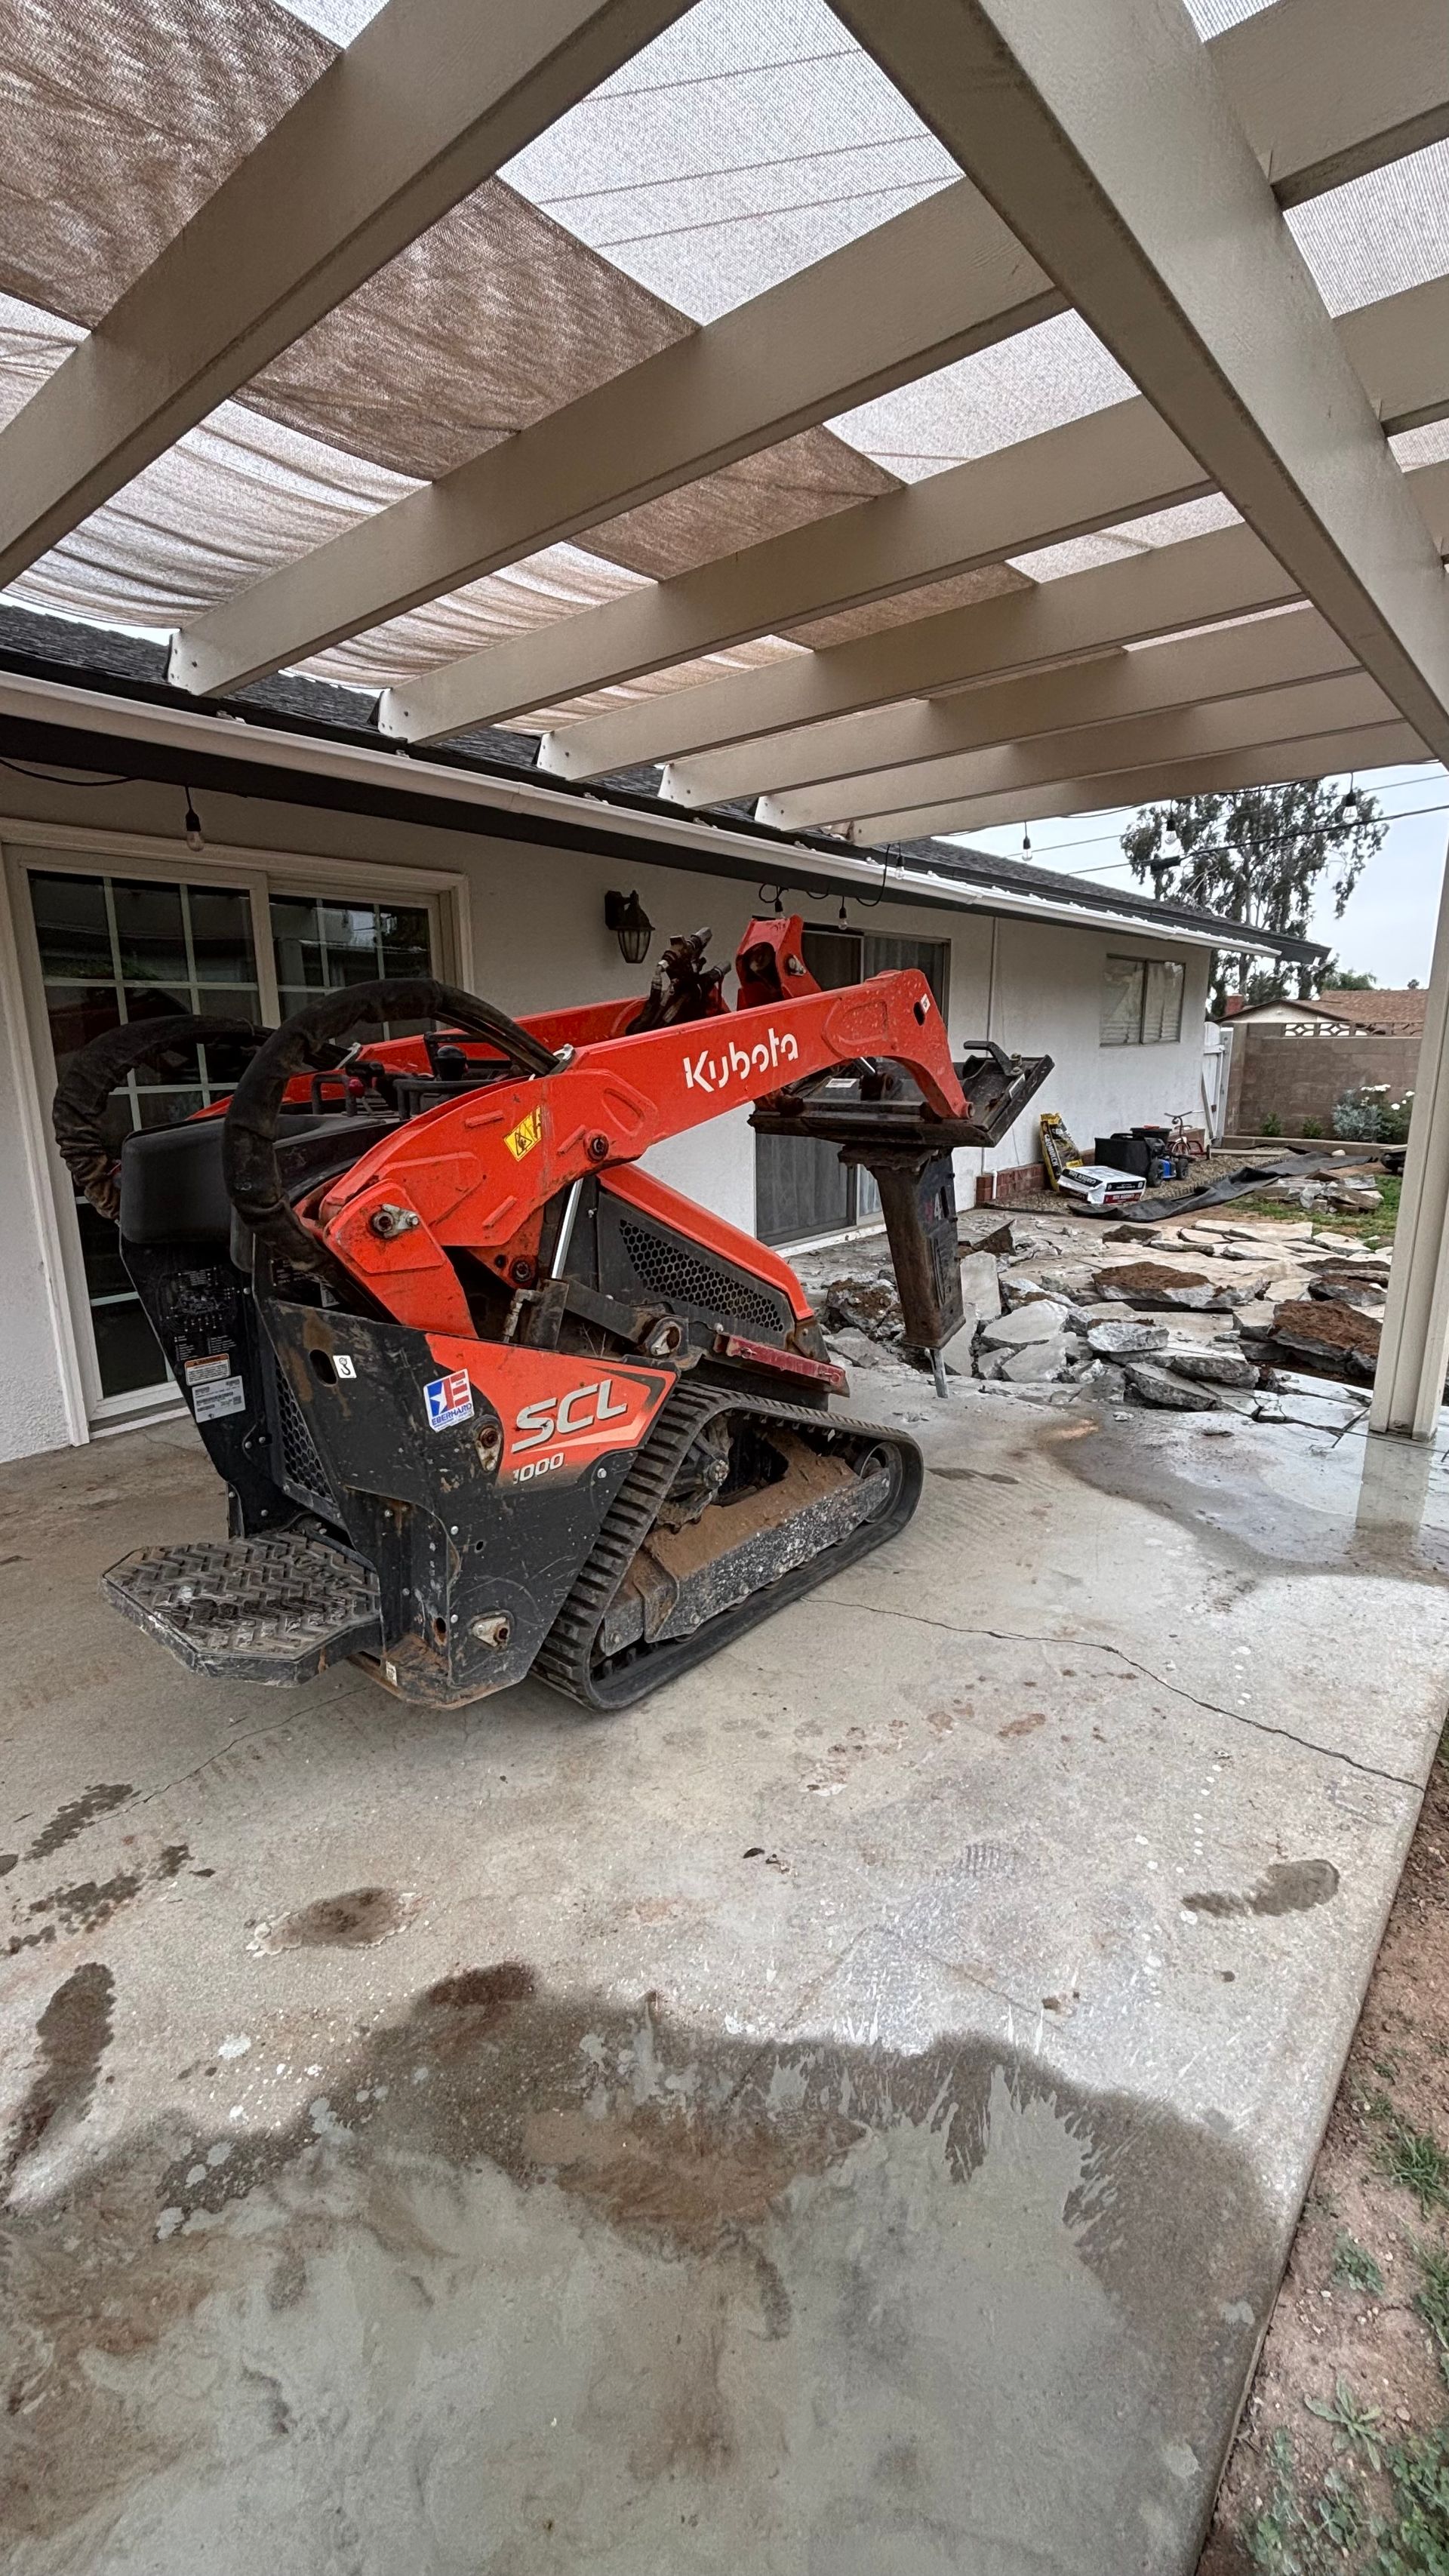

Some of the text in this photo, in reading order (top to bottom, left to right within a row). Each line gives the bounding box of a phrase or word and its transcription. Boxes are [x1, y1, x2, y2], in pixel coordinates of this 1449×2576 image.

[683, 1027, 799, 1093] Kubota
[432, 1402, 472, 1426] EBERHARD
[511, 1378, 629, 1454] SCL
[512, 1451, 565, 1485] 1000
